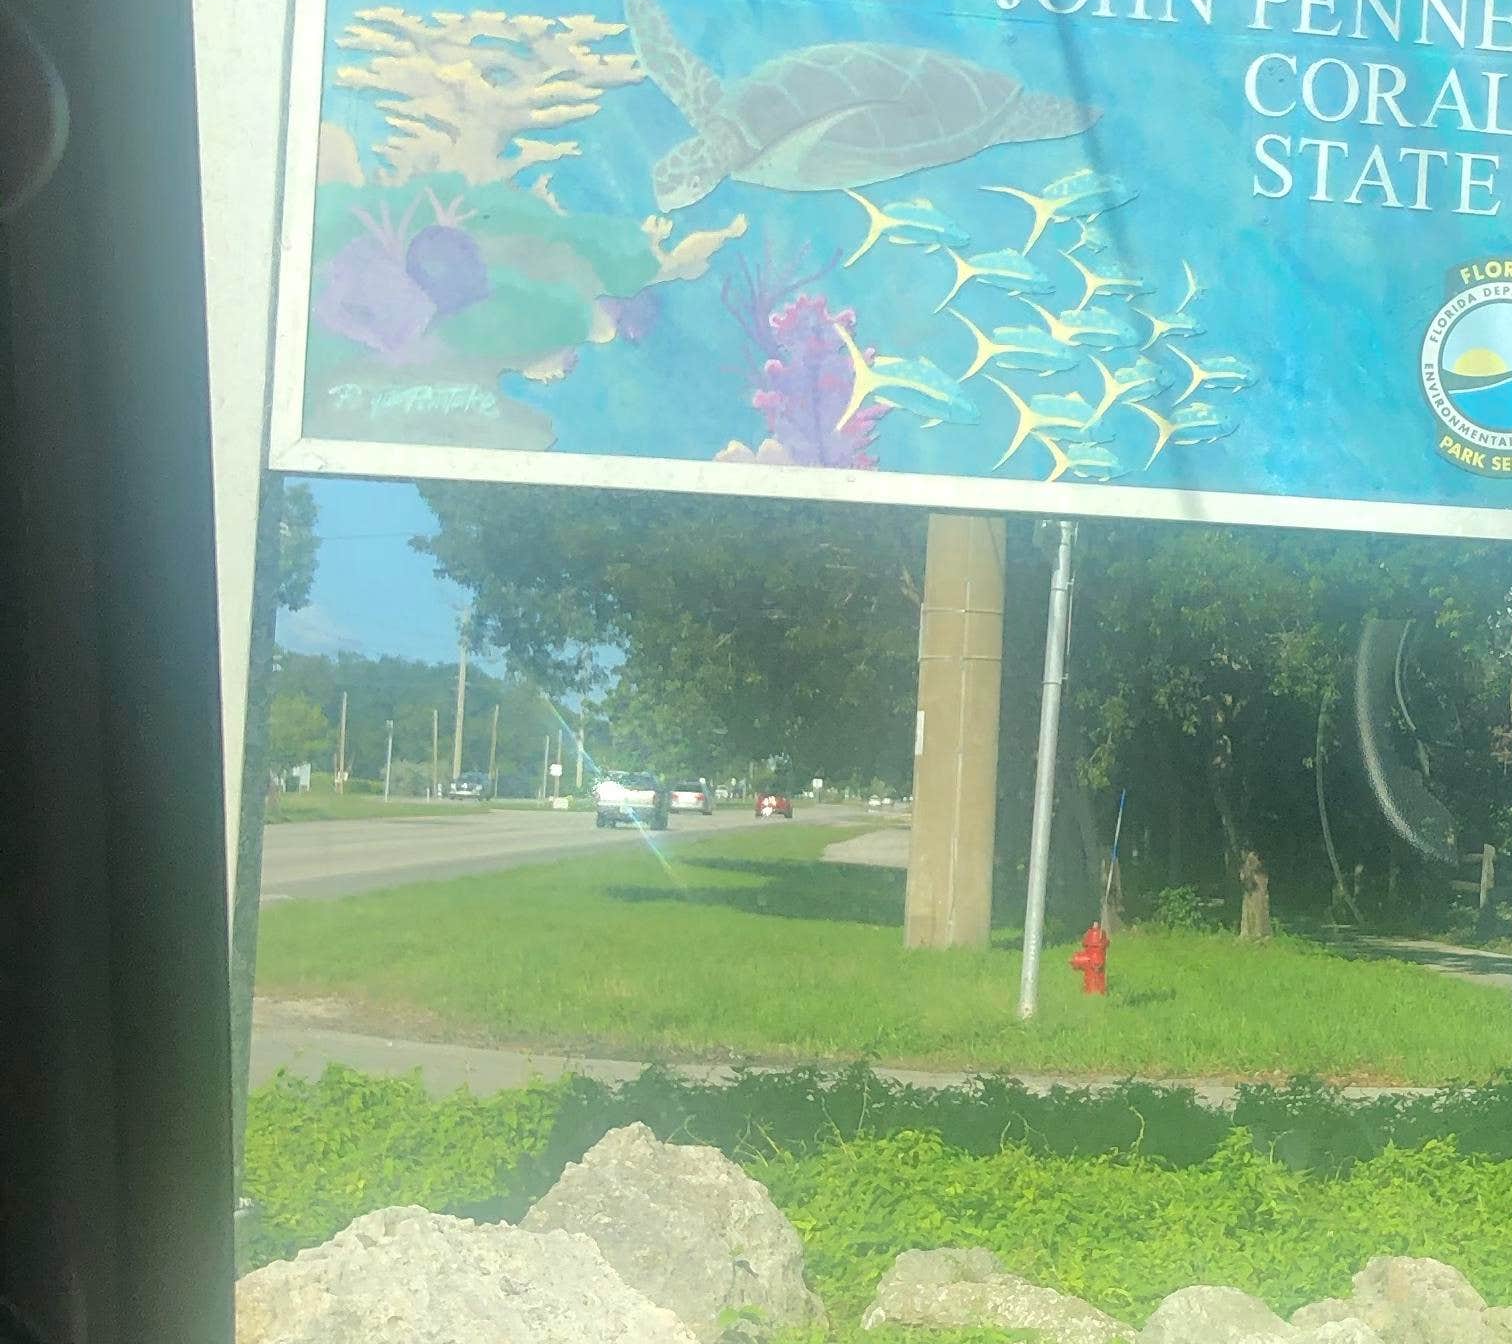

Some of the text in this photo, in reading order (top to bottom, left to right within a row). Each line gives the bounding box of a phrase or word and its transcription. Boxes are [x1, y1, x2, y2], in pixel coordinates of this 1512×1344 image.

[1252, 133, 1503, 216] STATE
[1429, 292, 1478, 344] FLORIDA
[1439, 435, 1487, 469] PARK
